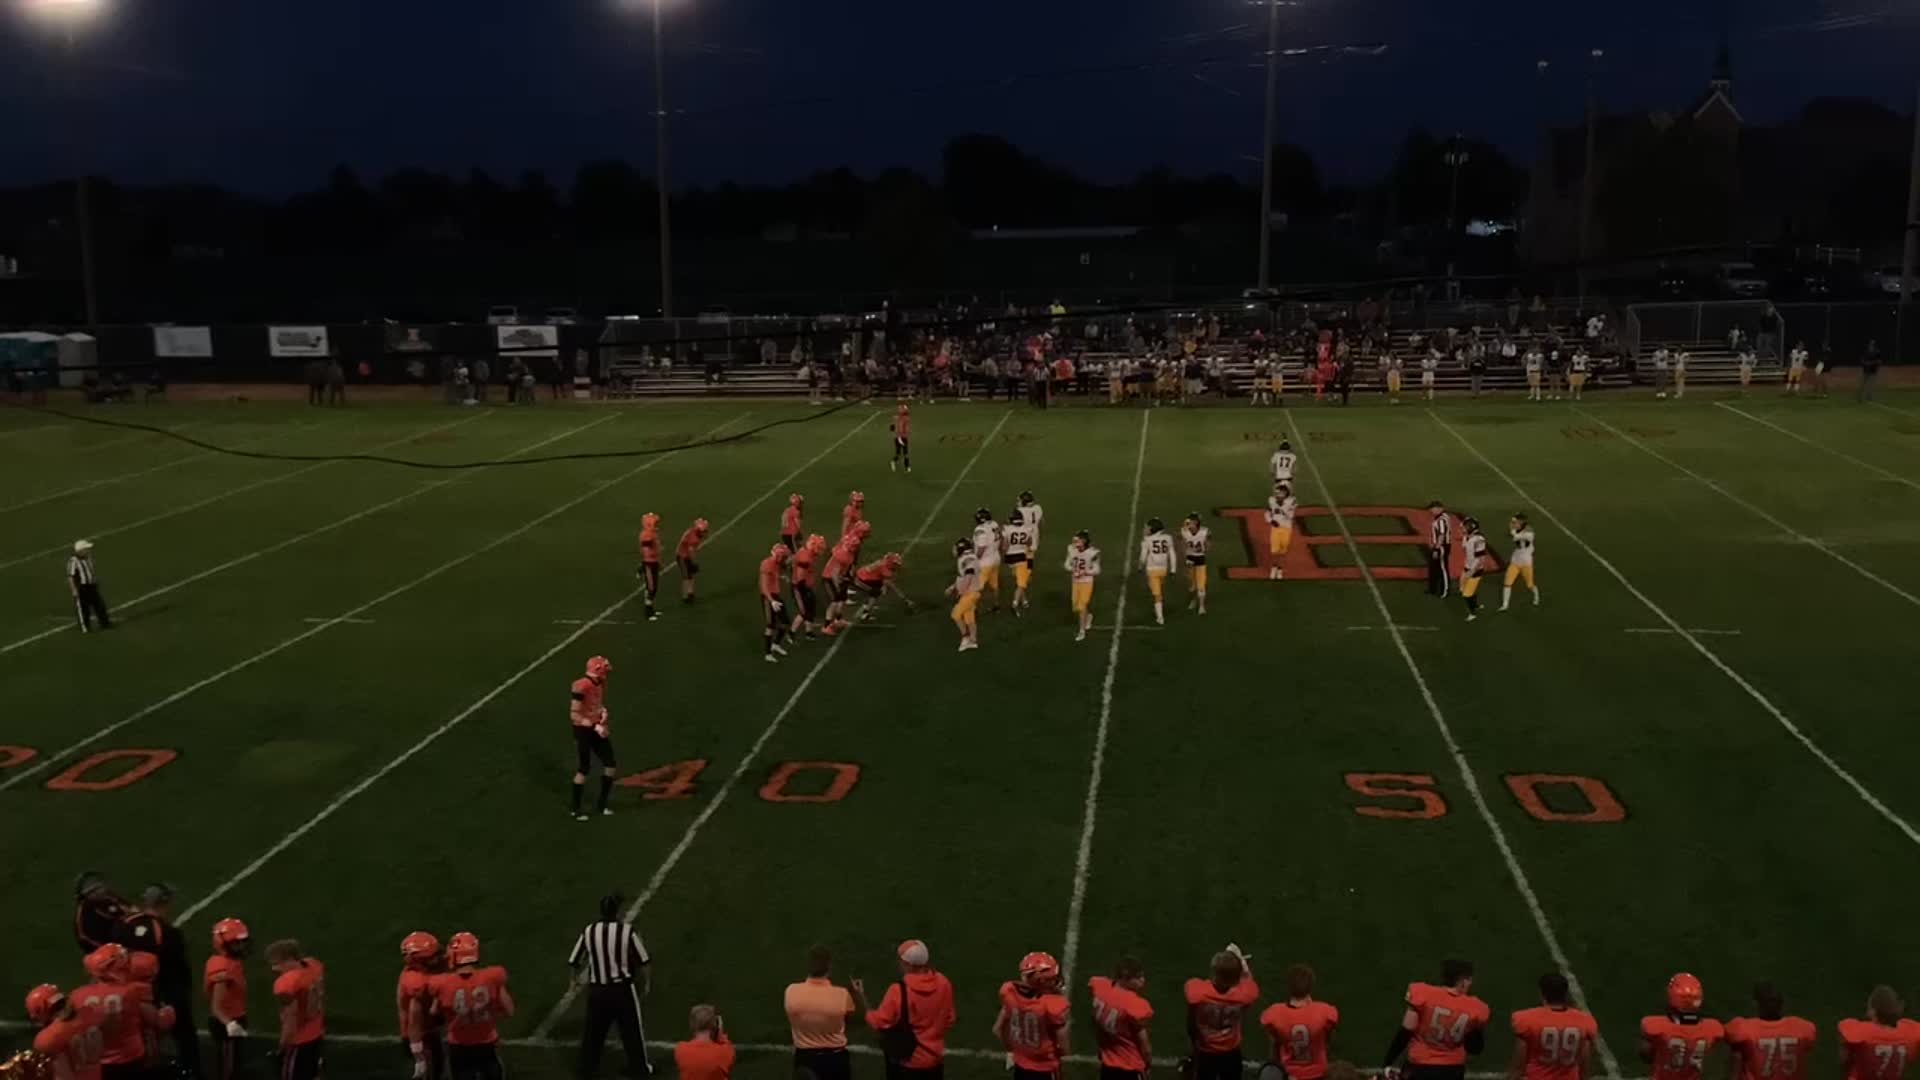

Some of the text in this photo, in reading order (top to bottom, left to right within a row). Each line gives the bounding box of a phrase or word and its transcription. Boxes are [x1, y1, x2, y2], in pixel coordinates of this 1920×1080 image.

[1010, 531, 1029, 545] 62
[1152, 540, 1168, 554] 56
[1430, 1006, 1470, 1044] 54
[1541, 1026, 1581, 1066] 99
[1759, 1037, 1799, 1077] 75
[1874, 1044, 1907, 1080] 71
